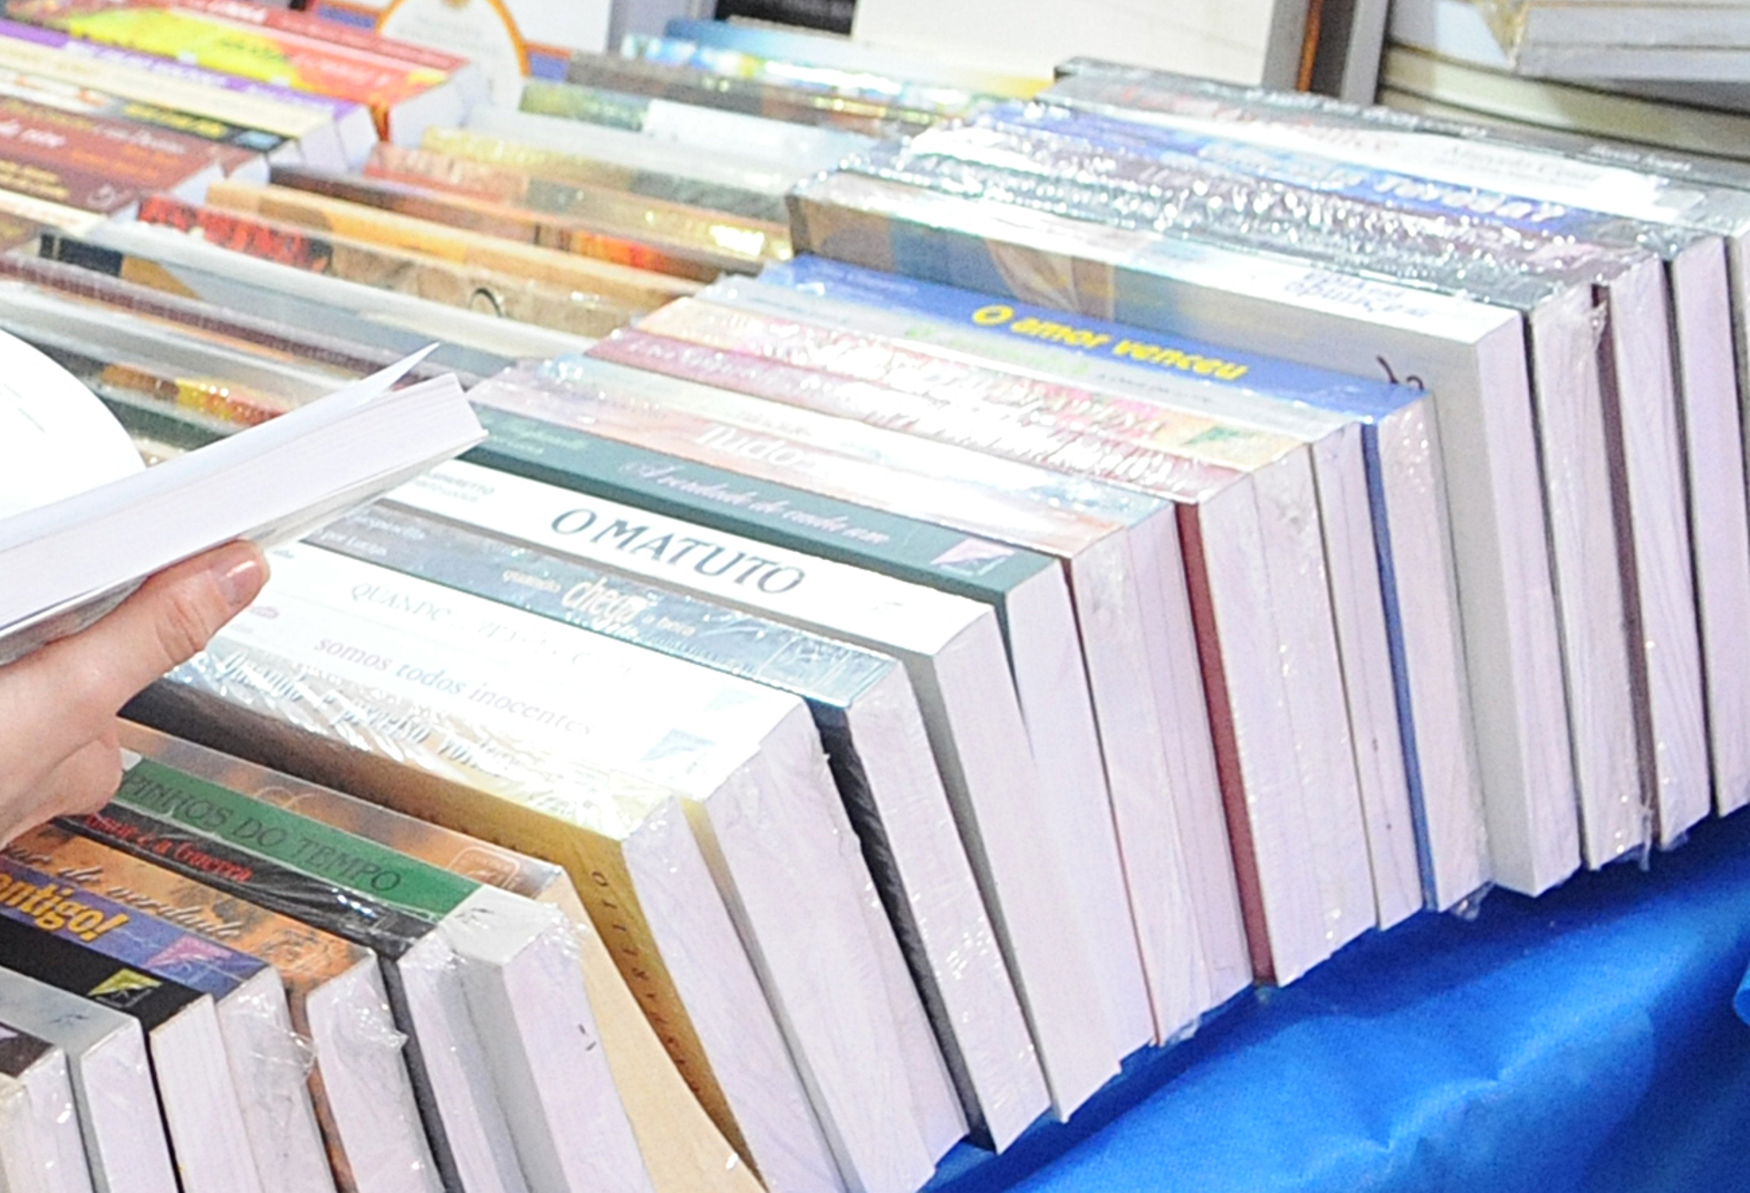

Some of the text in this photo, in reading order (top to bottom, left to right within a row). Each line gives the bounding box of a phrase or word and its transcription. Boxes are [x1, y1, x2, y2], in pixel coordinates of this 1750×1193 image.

[972, 304, 1015, 327] O
[1010, 316, 1111, 350] amor
[1112, 338, 1248, 382] venceu
[551, 508, 807, 595] O MATUTO
[502, 568, 562, 594] quando
[562, 576, 647, 632] chega
[314, 637, 393, 673] somos
[396, 662, 467, 697] todos
[467, 680, 594, 738] inocentes
[125, 770, 402, 892] PINHOS DO TEMPO
[58, 865, 105, 885] de
[107, 886, 243, 938] verdade
